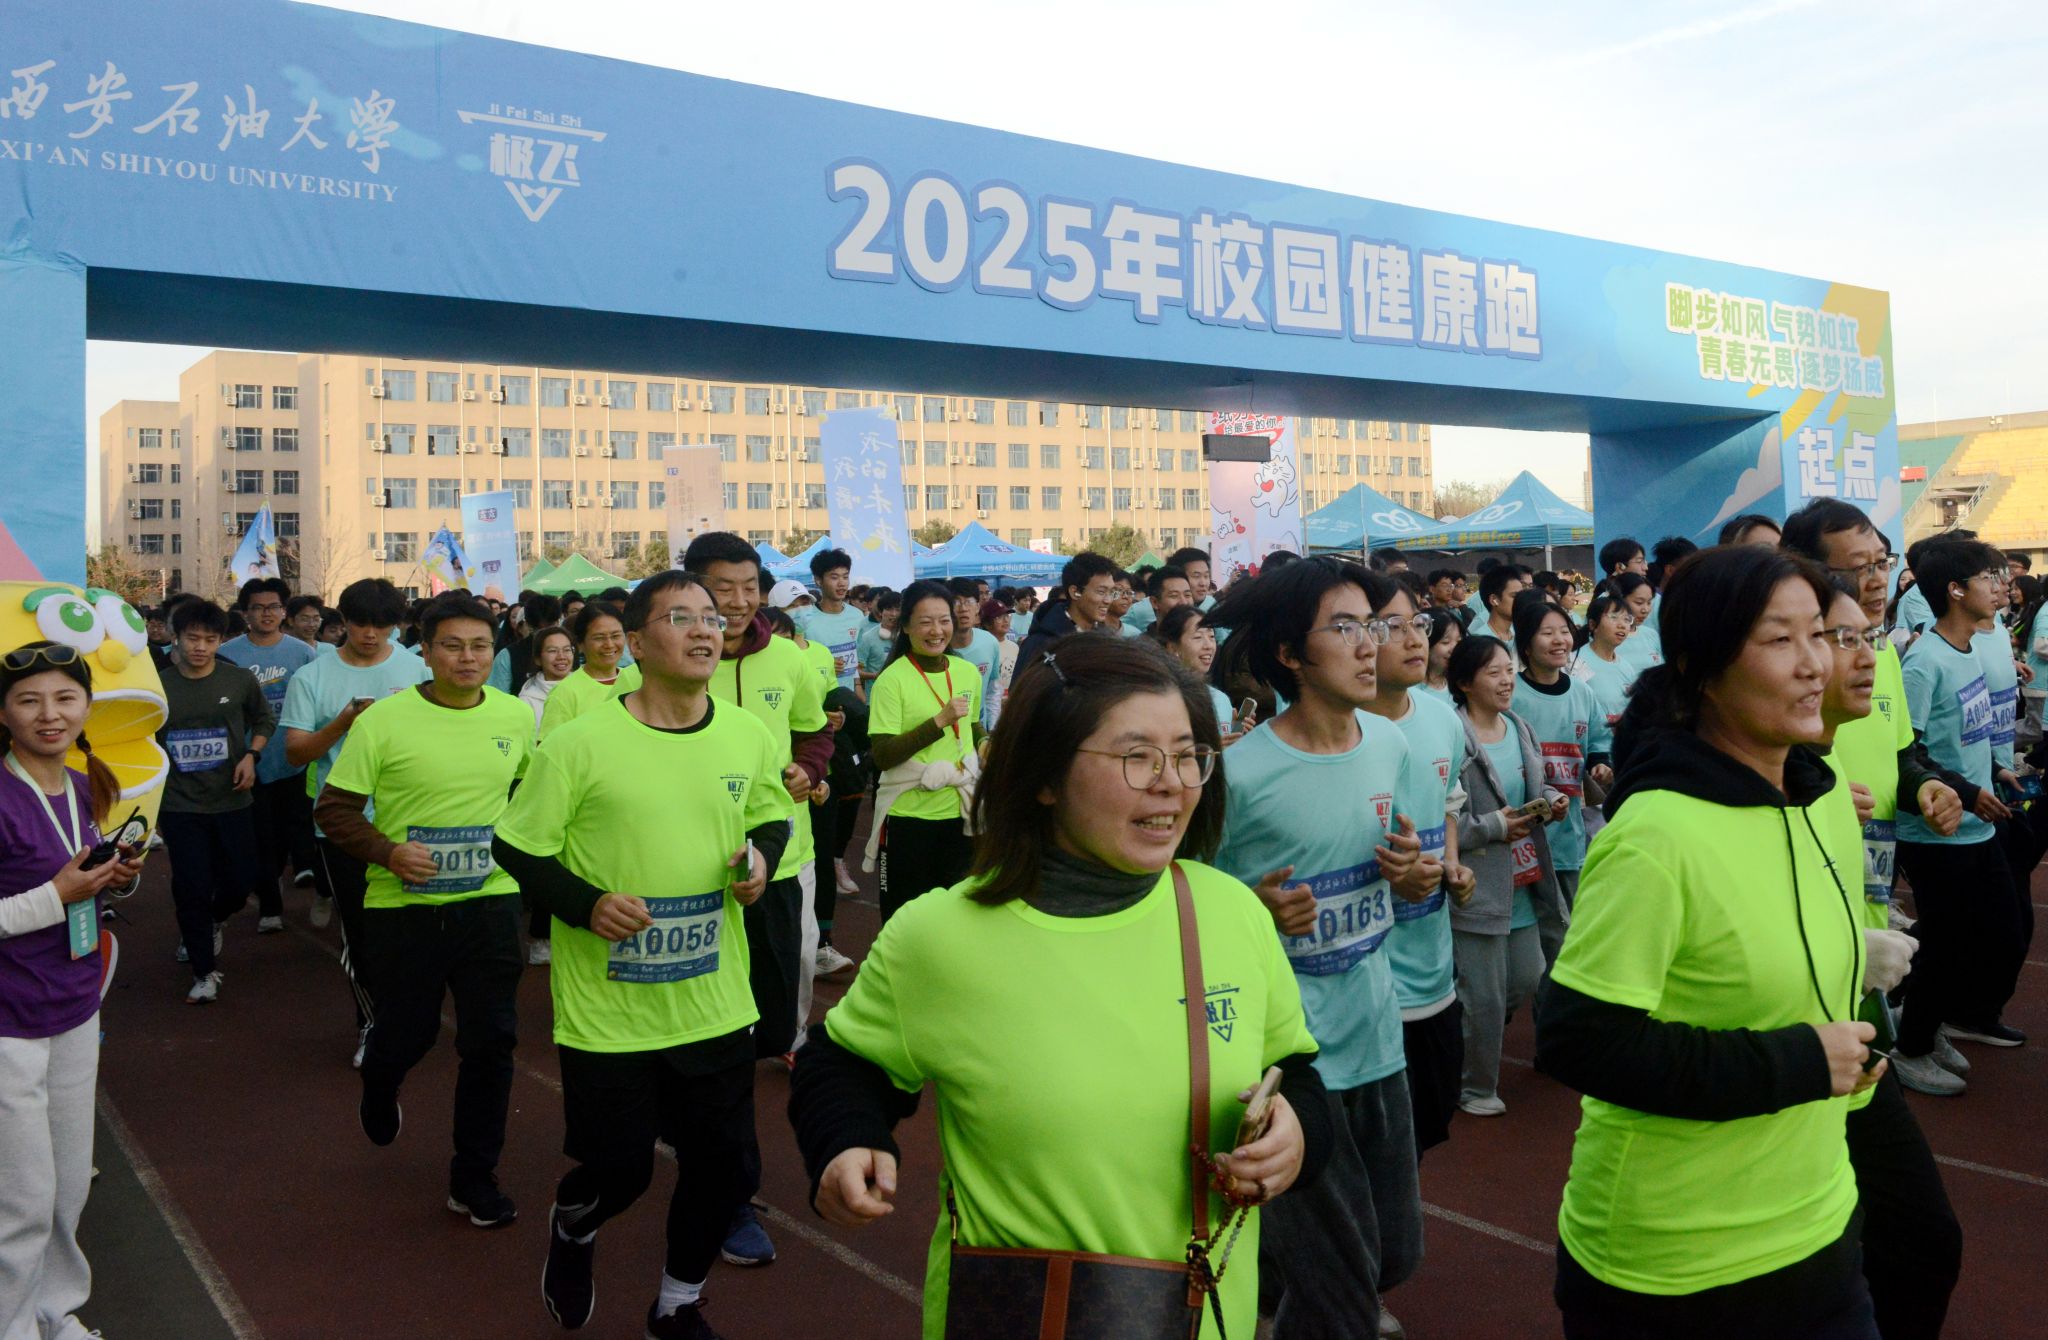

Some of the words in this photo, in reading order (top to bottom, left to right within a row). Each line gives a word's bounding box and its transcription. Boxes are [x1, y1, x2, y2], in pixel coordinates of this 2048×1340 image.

[487, 103, 500, 115] Ji
[506, 105, 527, 120] Fei
[560, 114, 582, 128] Shi
[100, 151, 217, 182] SHIYOU
[228, 165, 398, 202] UNIVERSITY
[830, 163, 1542, 355] 2025年校园健康跑
[1668, 287, 1767, 341] 脚步如风
[1773, 305, 1859, 353] 气势如虹
[1700, 335, 1795, 384] 青春无畏
[1801, 350, 1883, 394] 逐梦扬威
[1798, 426, 1878, 500] 起点
[170, 741, 224, 759] A0792
[880, 851, 888, 892] MOMENT
[616, 919, 718, 955] A0058
